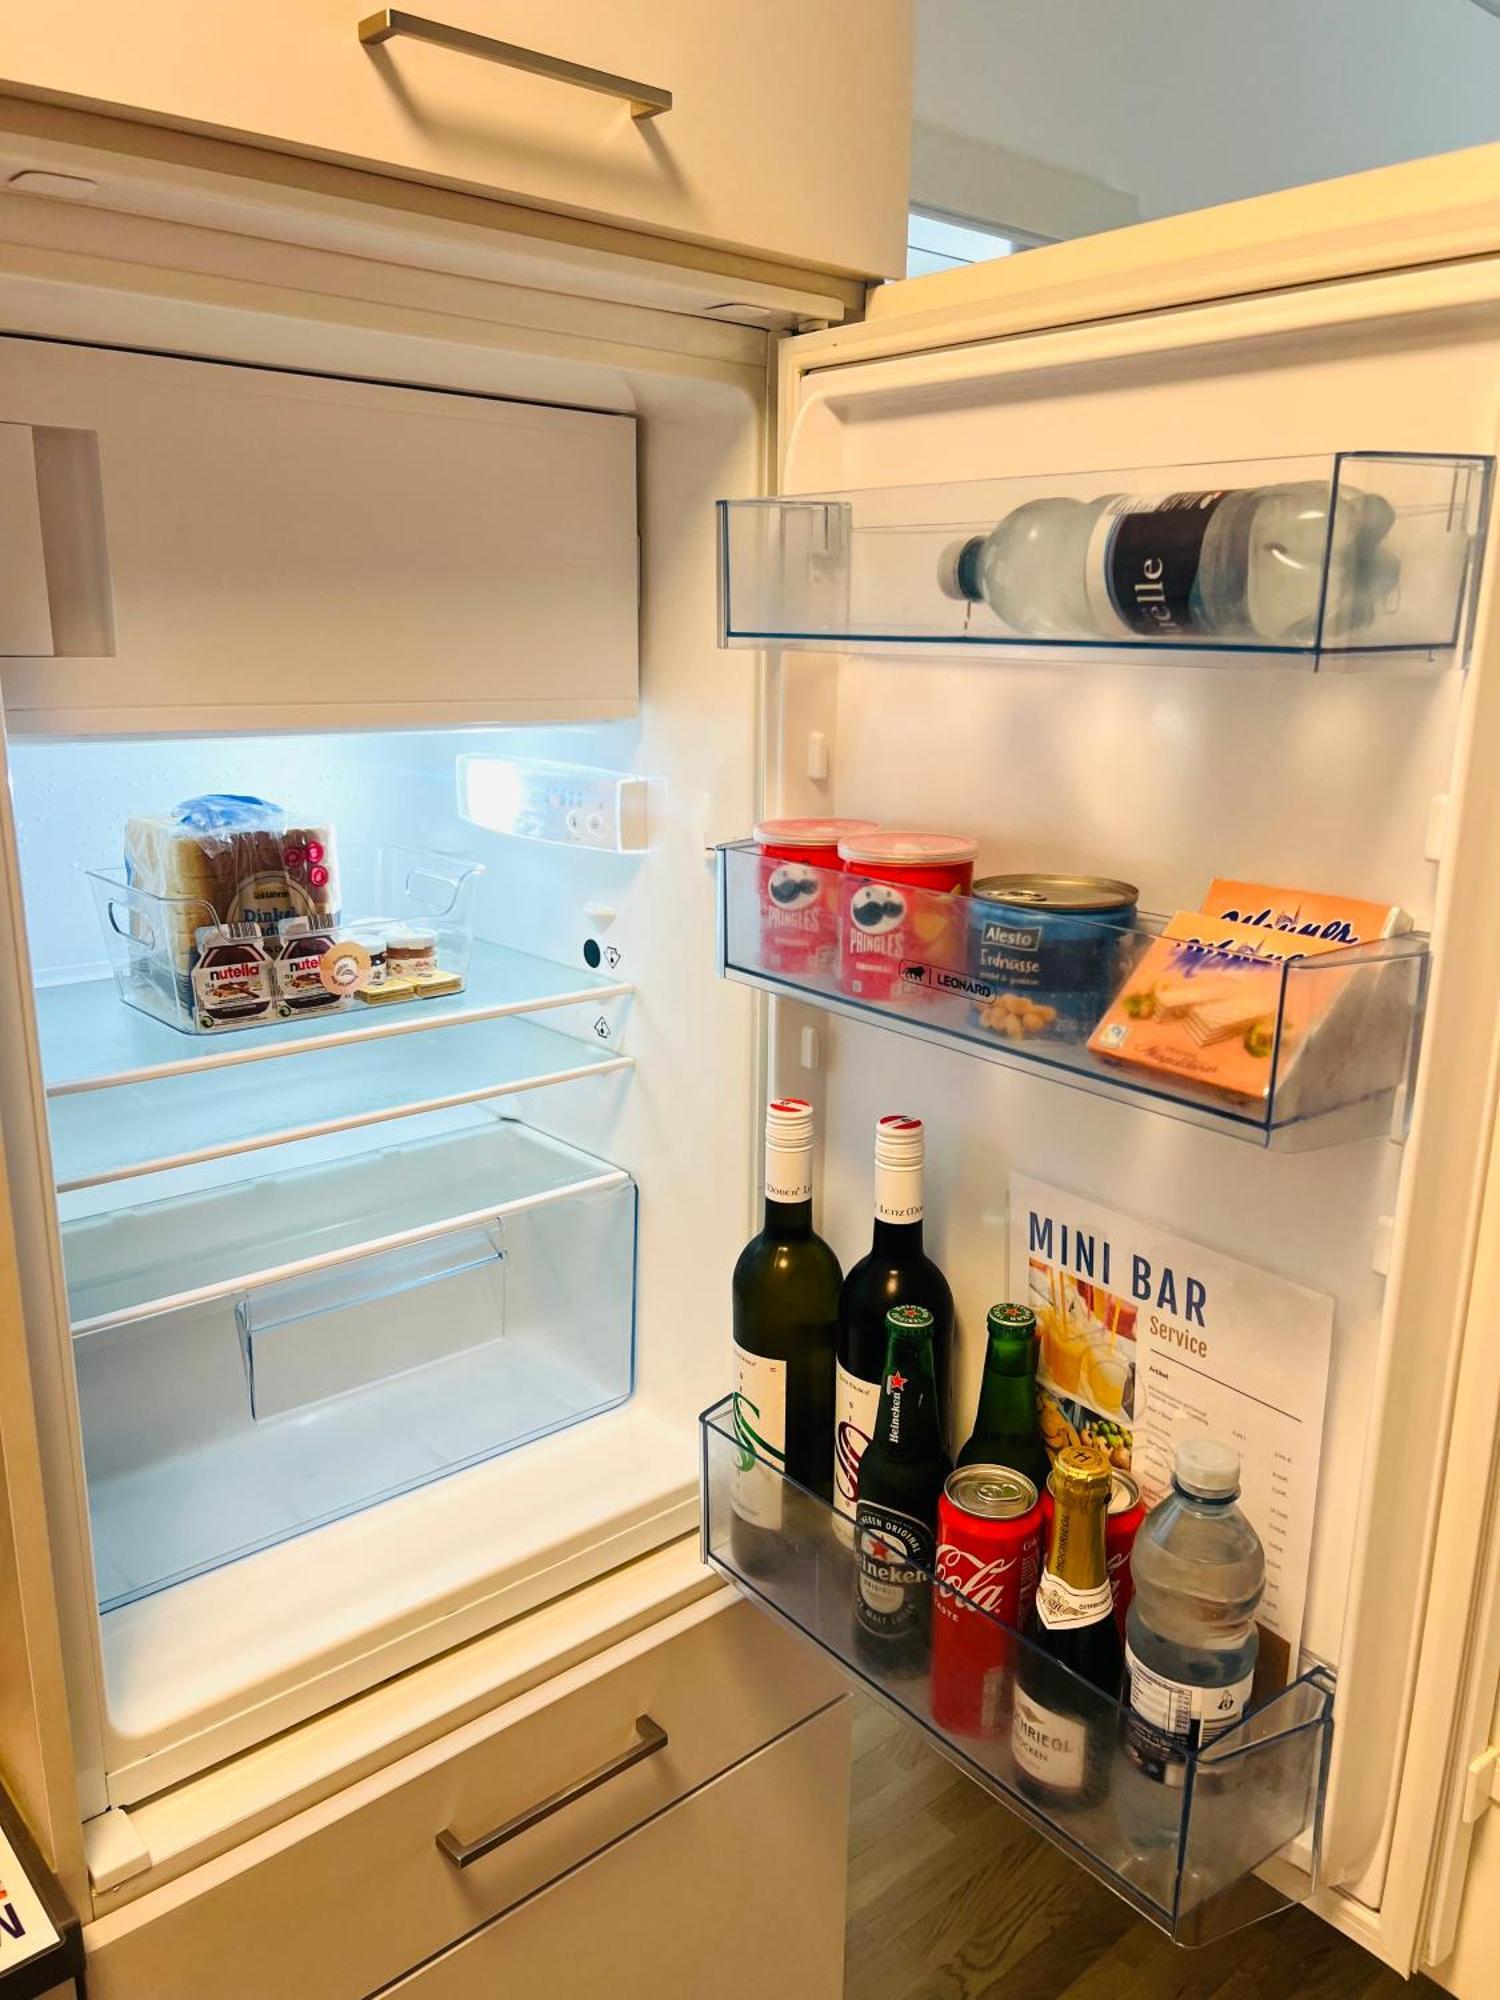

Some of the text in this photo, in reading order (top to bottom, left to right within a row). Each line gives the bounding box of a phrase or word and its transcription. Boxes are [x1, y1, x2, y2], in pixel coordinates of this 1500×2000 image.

[767, 906, 819, 932] PRINGLES
[850, 931, 904, 958] PRINGLES
[985, 926, 1033, 947] Alesto
[210, 963, 260, 981] nutella
[937, 972, 991, 999] LEONARD
[1028, 1211, 1207, 1328] MINI BAR
[1149, 1315, 1208, 1358] Service
[888, 1391, 901, 1444] Heineken
